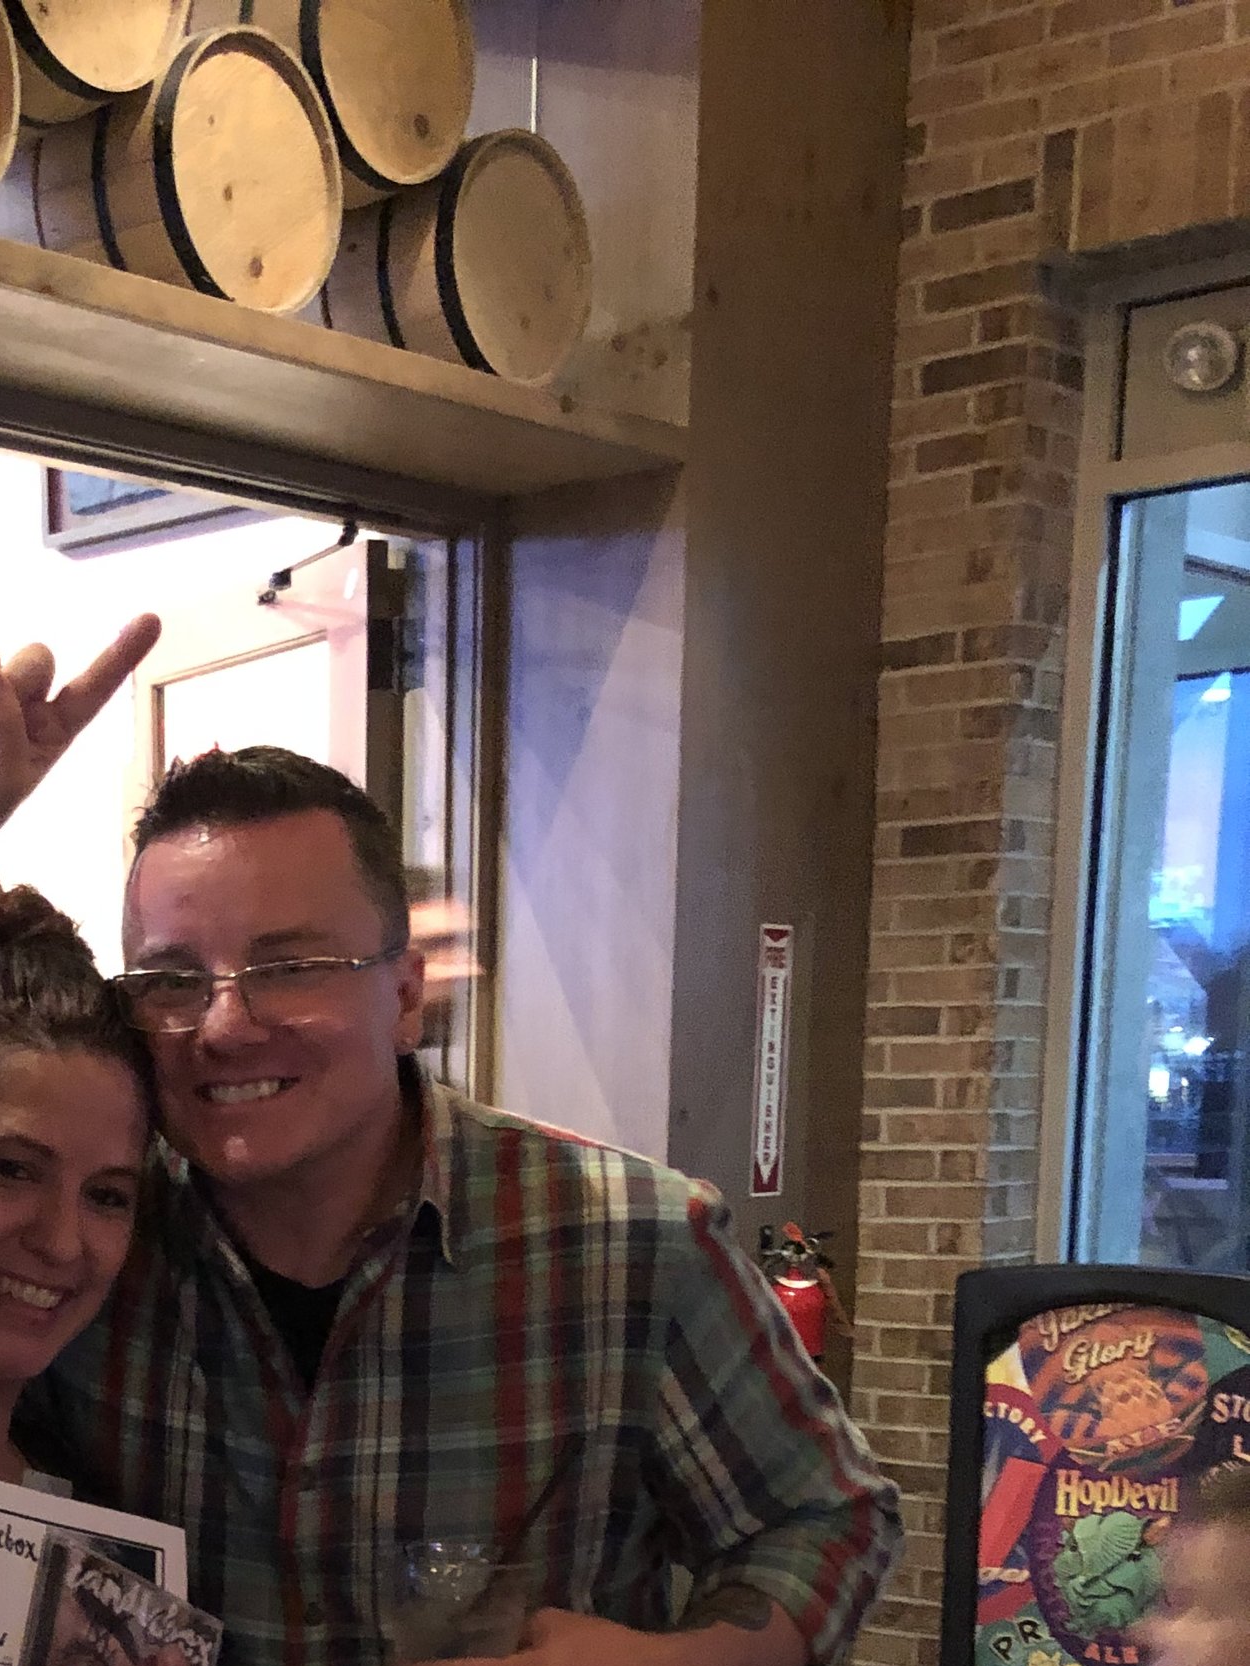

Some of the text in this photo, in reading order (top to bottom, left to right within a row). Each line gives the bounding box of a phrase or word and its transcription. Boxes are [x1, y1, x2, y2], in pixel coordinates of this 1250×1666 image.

[1063, 1330, 1155, 1384] Glory
[1054, 1467, 1180, 1517] HopDevil
[1083, 1642, 1140, 1665] ALE
